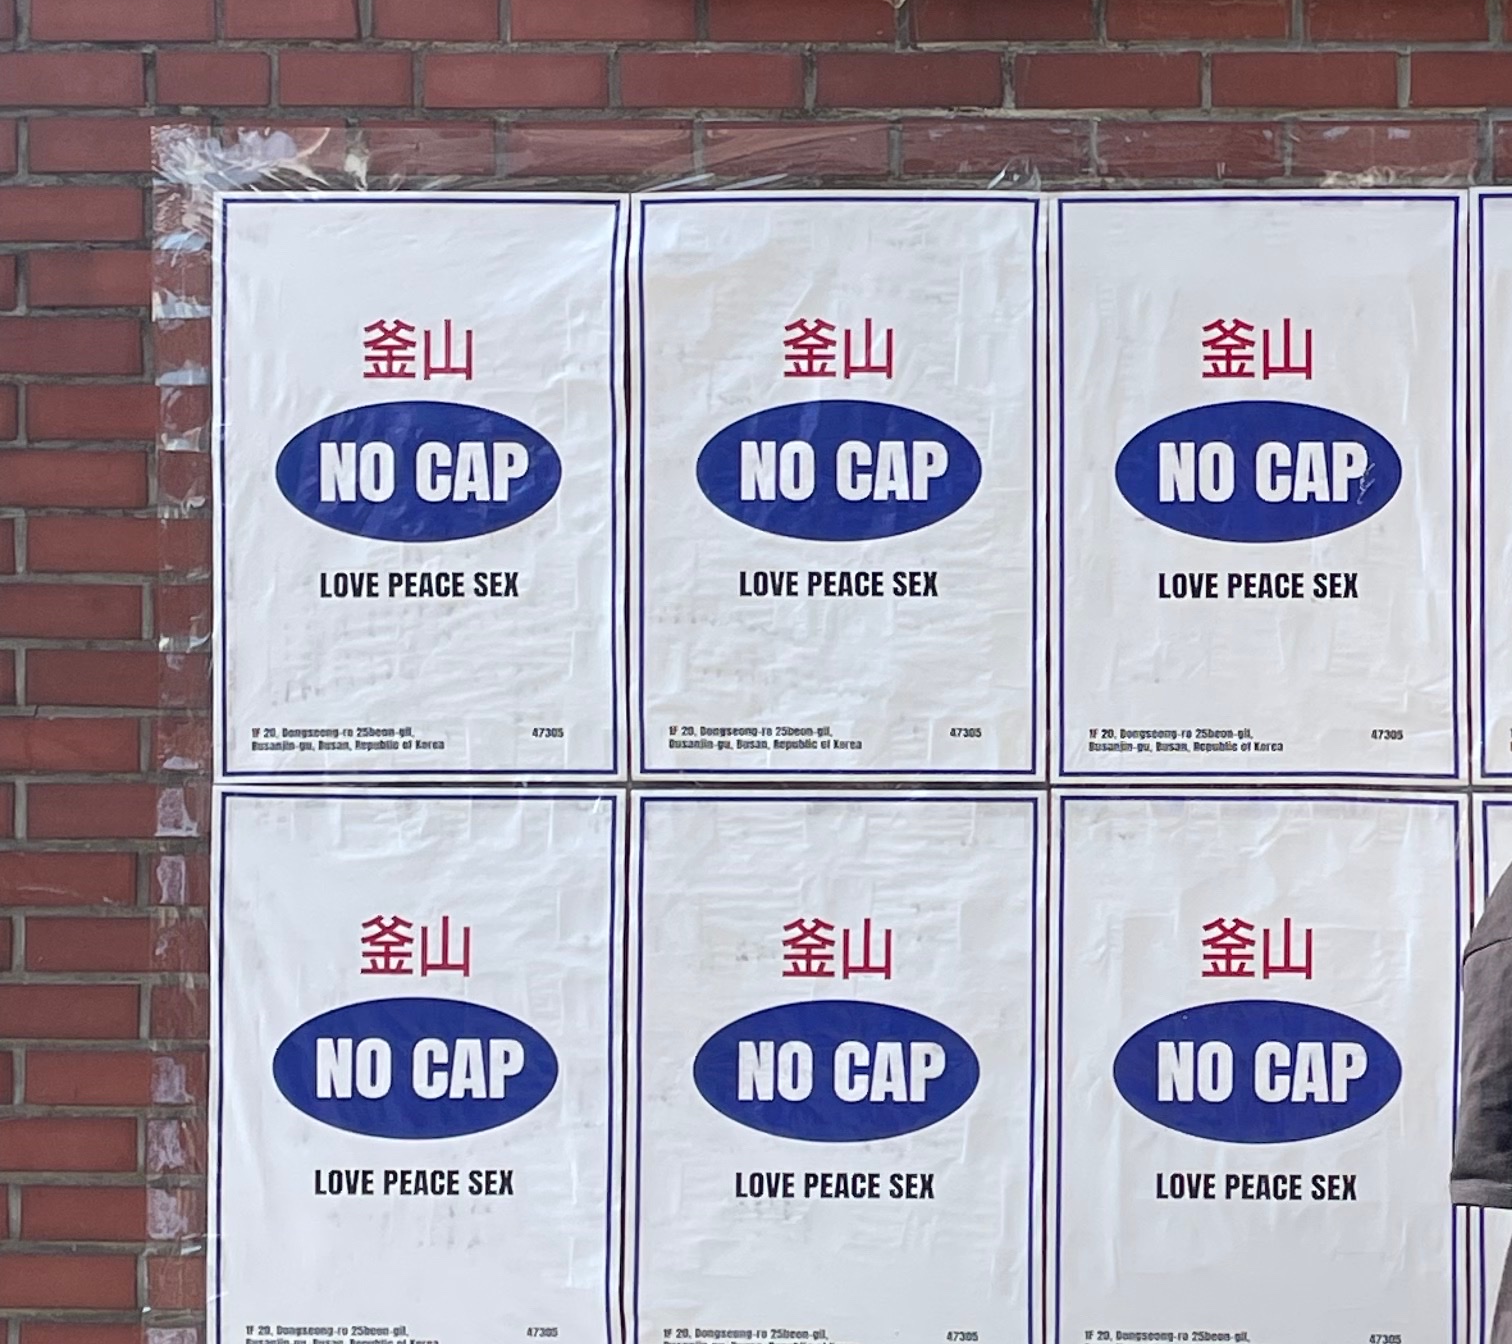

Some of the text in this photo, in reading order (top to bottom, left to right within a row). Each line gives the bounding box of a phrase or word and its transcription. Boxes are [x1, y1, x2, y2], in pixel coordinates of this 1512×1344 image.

[364, 320, 473, 379] 釜山
[784, 319, 894, 379] 釜山
[1202, 317, 1313, 380] 釜山
[320, 442, 529, 502] NO CAP
[741, 440, 948, 500] NO CAP
[1159, 442, 1368, 502] NO CAP
[320, 571, 519, 598] LOVE PEACE SEX
[739, 571, 938, 597] LOVE PEACE SEX
[1158, 572, 1359, 599] LOVE PEACE SEX
[362, 915, 470, 976] 釜山
[784, 918, 892, 979] 釜山
[1202, 917, 1313, 979] 釜山
[317, 1038, 524, 1099] NO CAP
[738, 1041, 945, 1102] NO CAP
[1158, 1041, 1367, 1102] NO CAP
[315, 1169, 514, 1196] LOVE PEACE SEX
[735, 1172, 935, 1199] LOVE PEACE SEX
[1156, 1172, 1357, 1201] LOVE PEACE SEX
